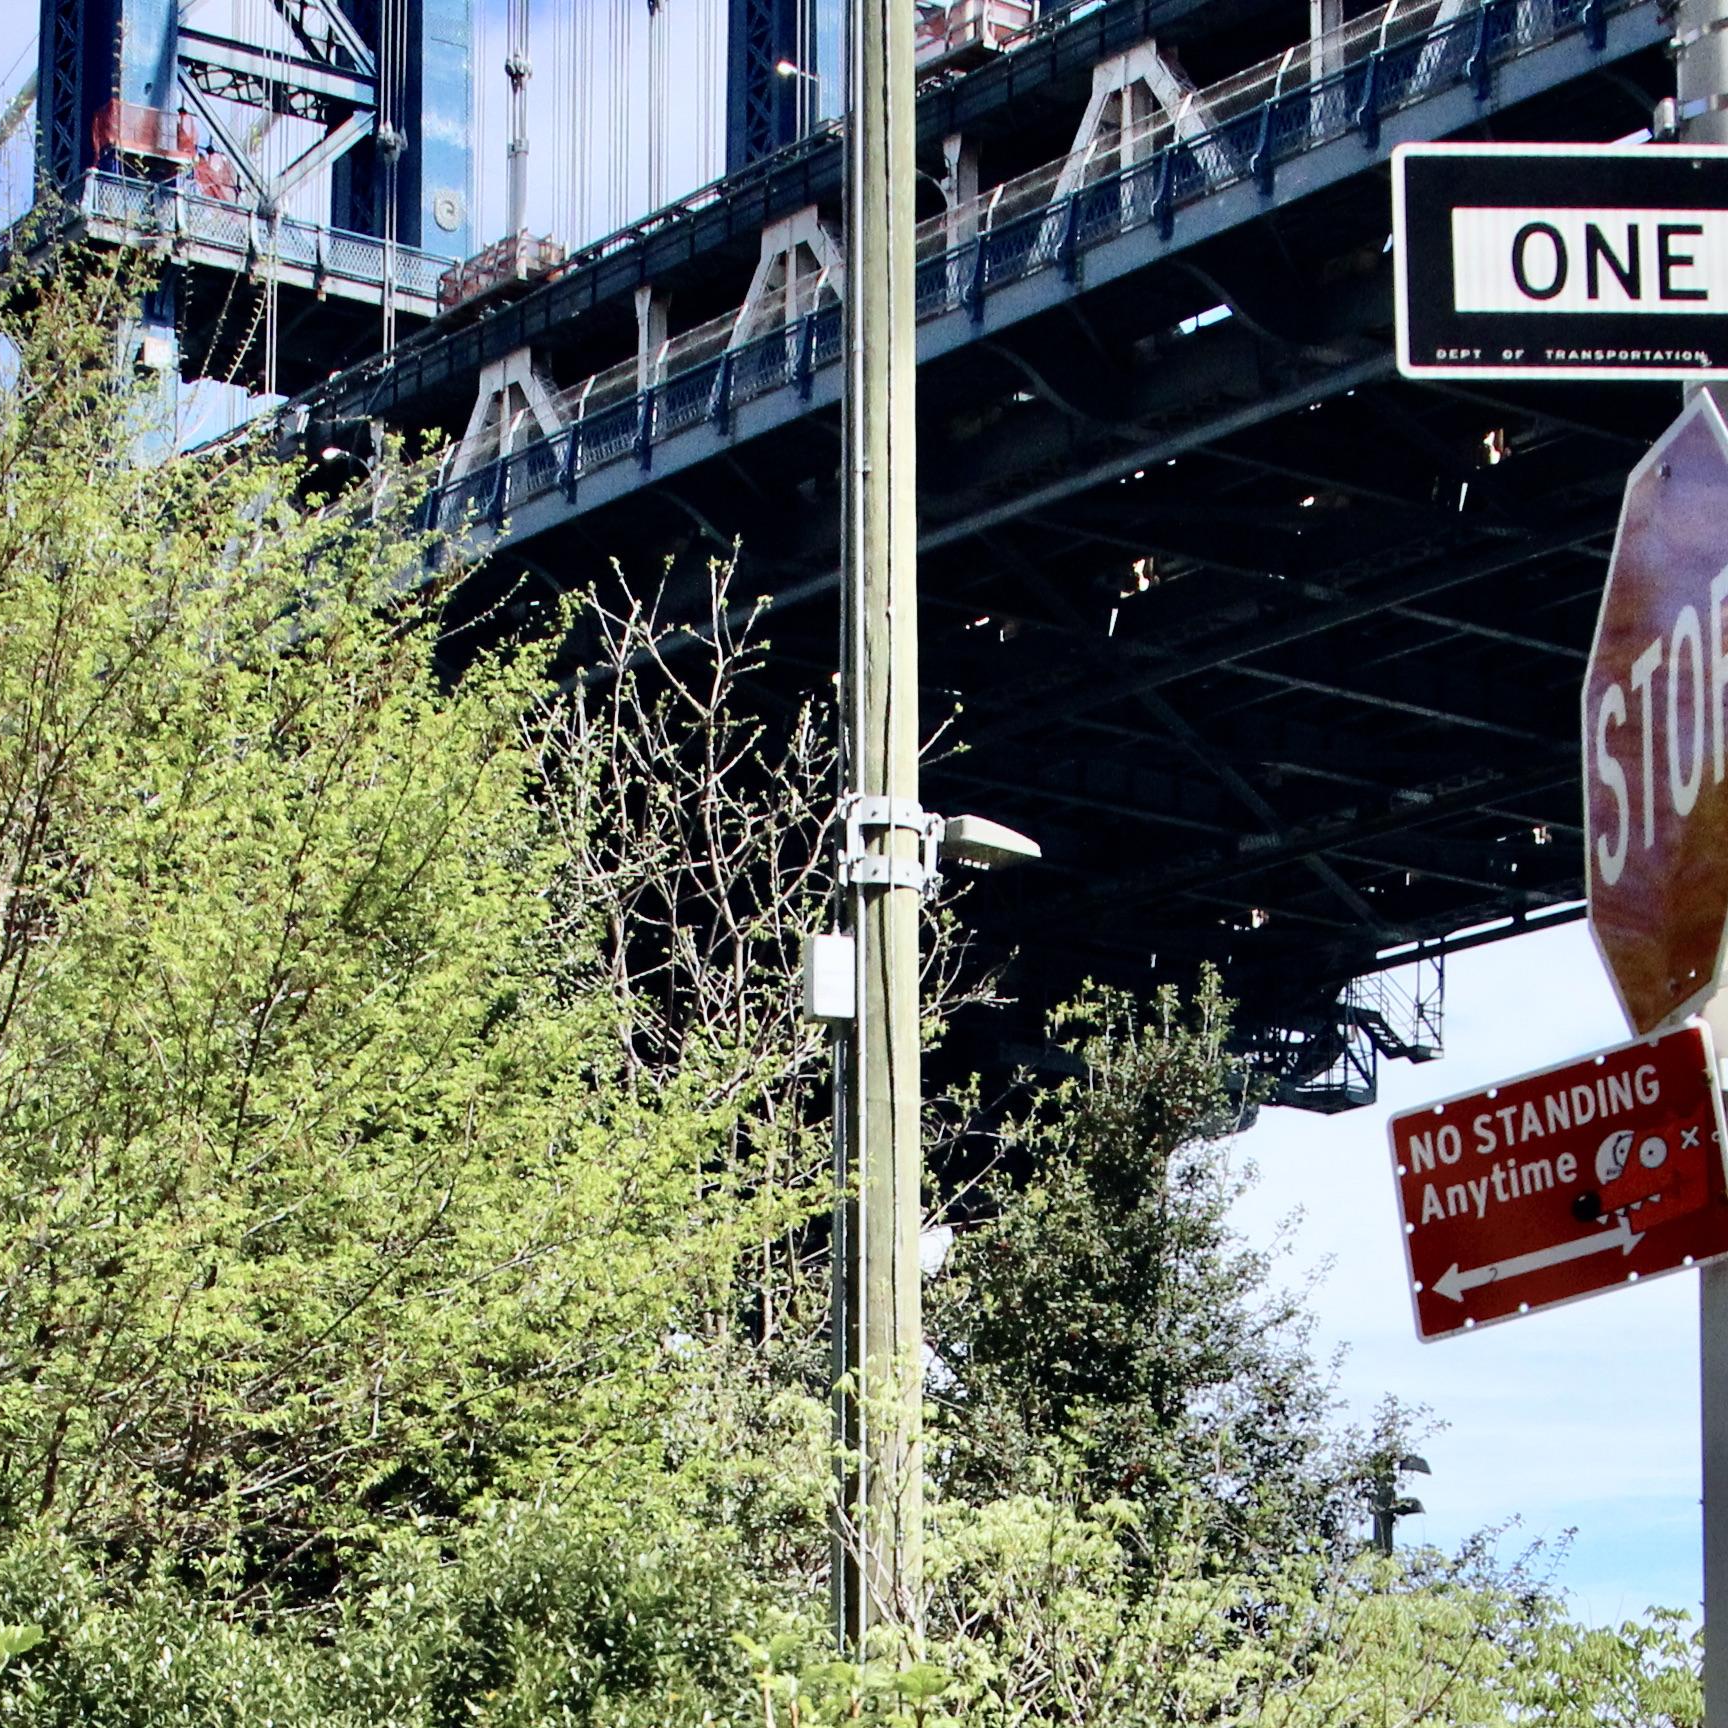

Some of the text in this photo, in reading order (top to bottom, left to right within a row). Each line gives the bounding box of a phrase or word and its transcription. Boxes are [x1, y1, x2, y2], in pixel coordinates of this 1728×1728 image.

[1511, 222, 1708, 302] ONE
[1436, 349, 1706, 361] DEPT OF TRANSPORTATION
[1409, 1064, 1660, 1173] NO STANDING
[1421, 1152, 1577, 1224] Anytime
